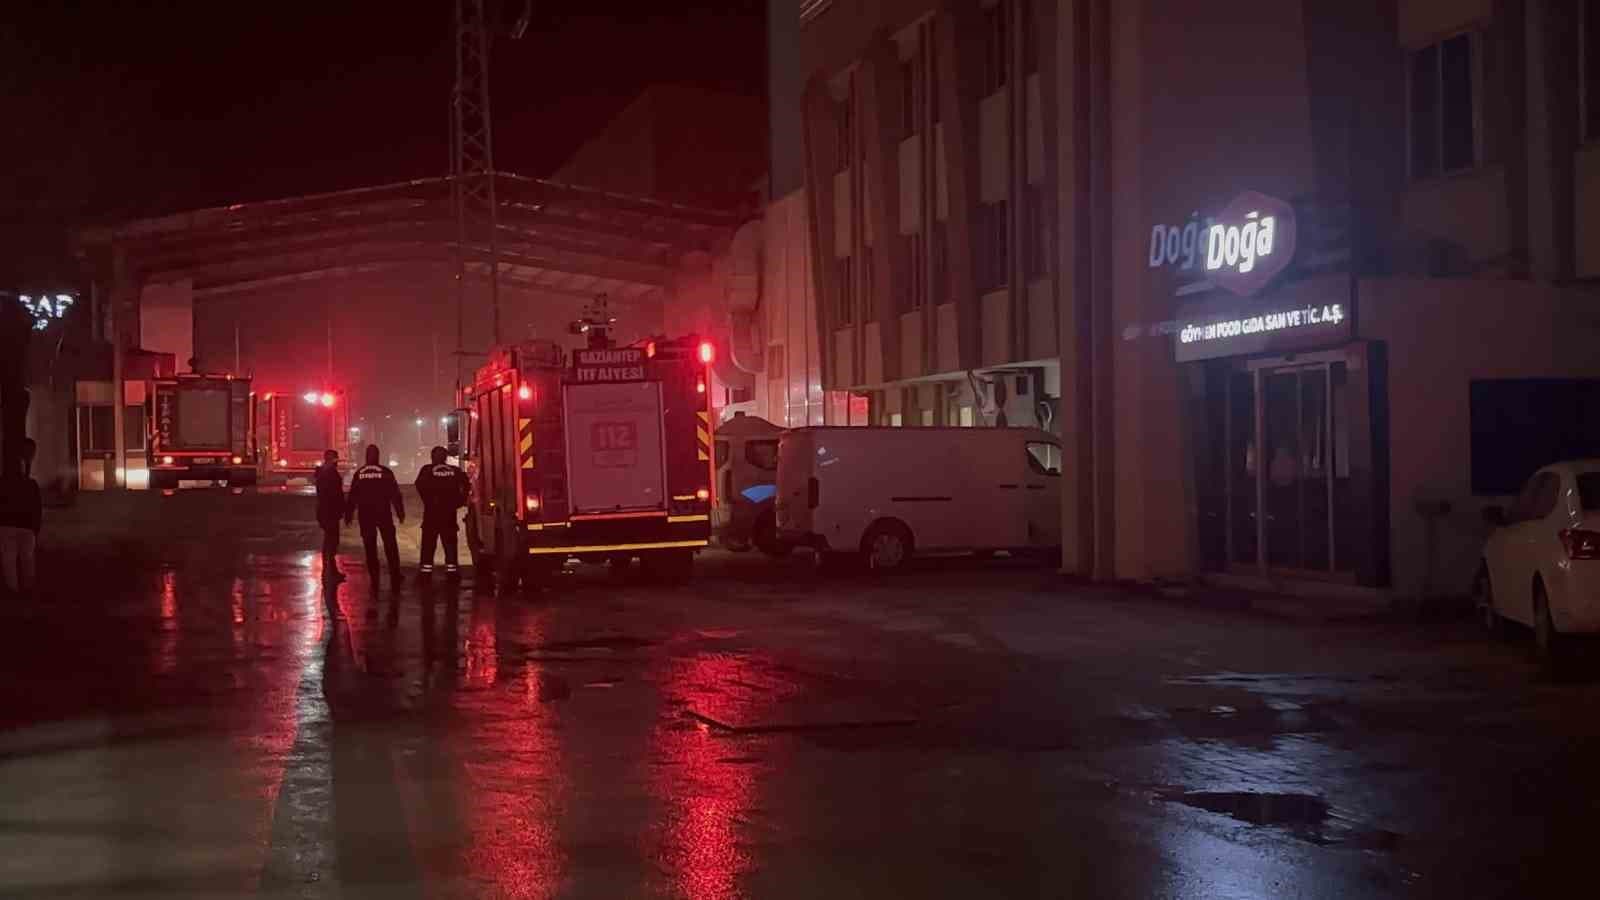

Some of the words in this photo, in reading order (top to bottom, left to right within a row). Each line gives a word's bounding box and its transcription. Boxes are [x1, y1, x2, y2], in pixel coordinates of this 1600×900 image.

[1207, 211, 1275, 273] Doğa
[1286, 310, 1301, 328] VE
[598, 425, 631, 449] 112
